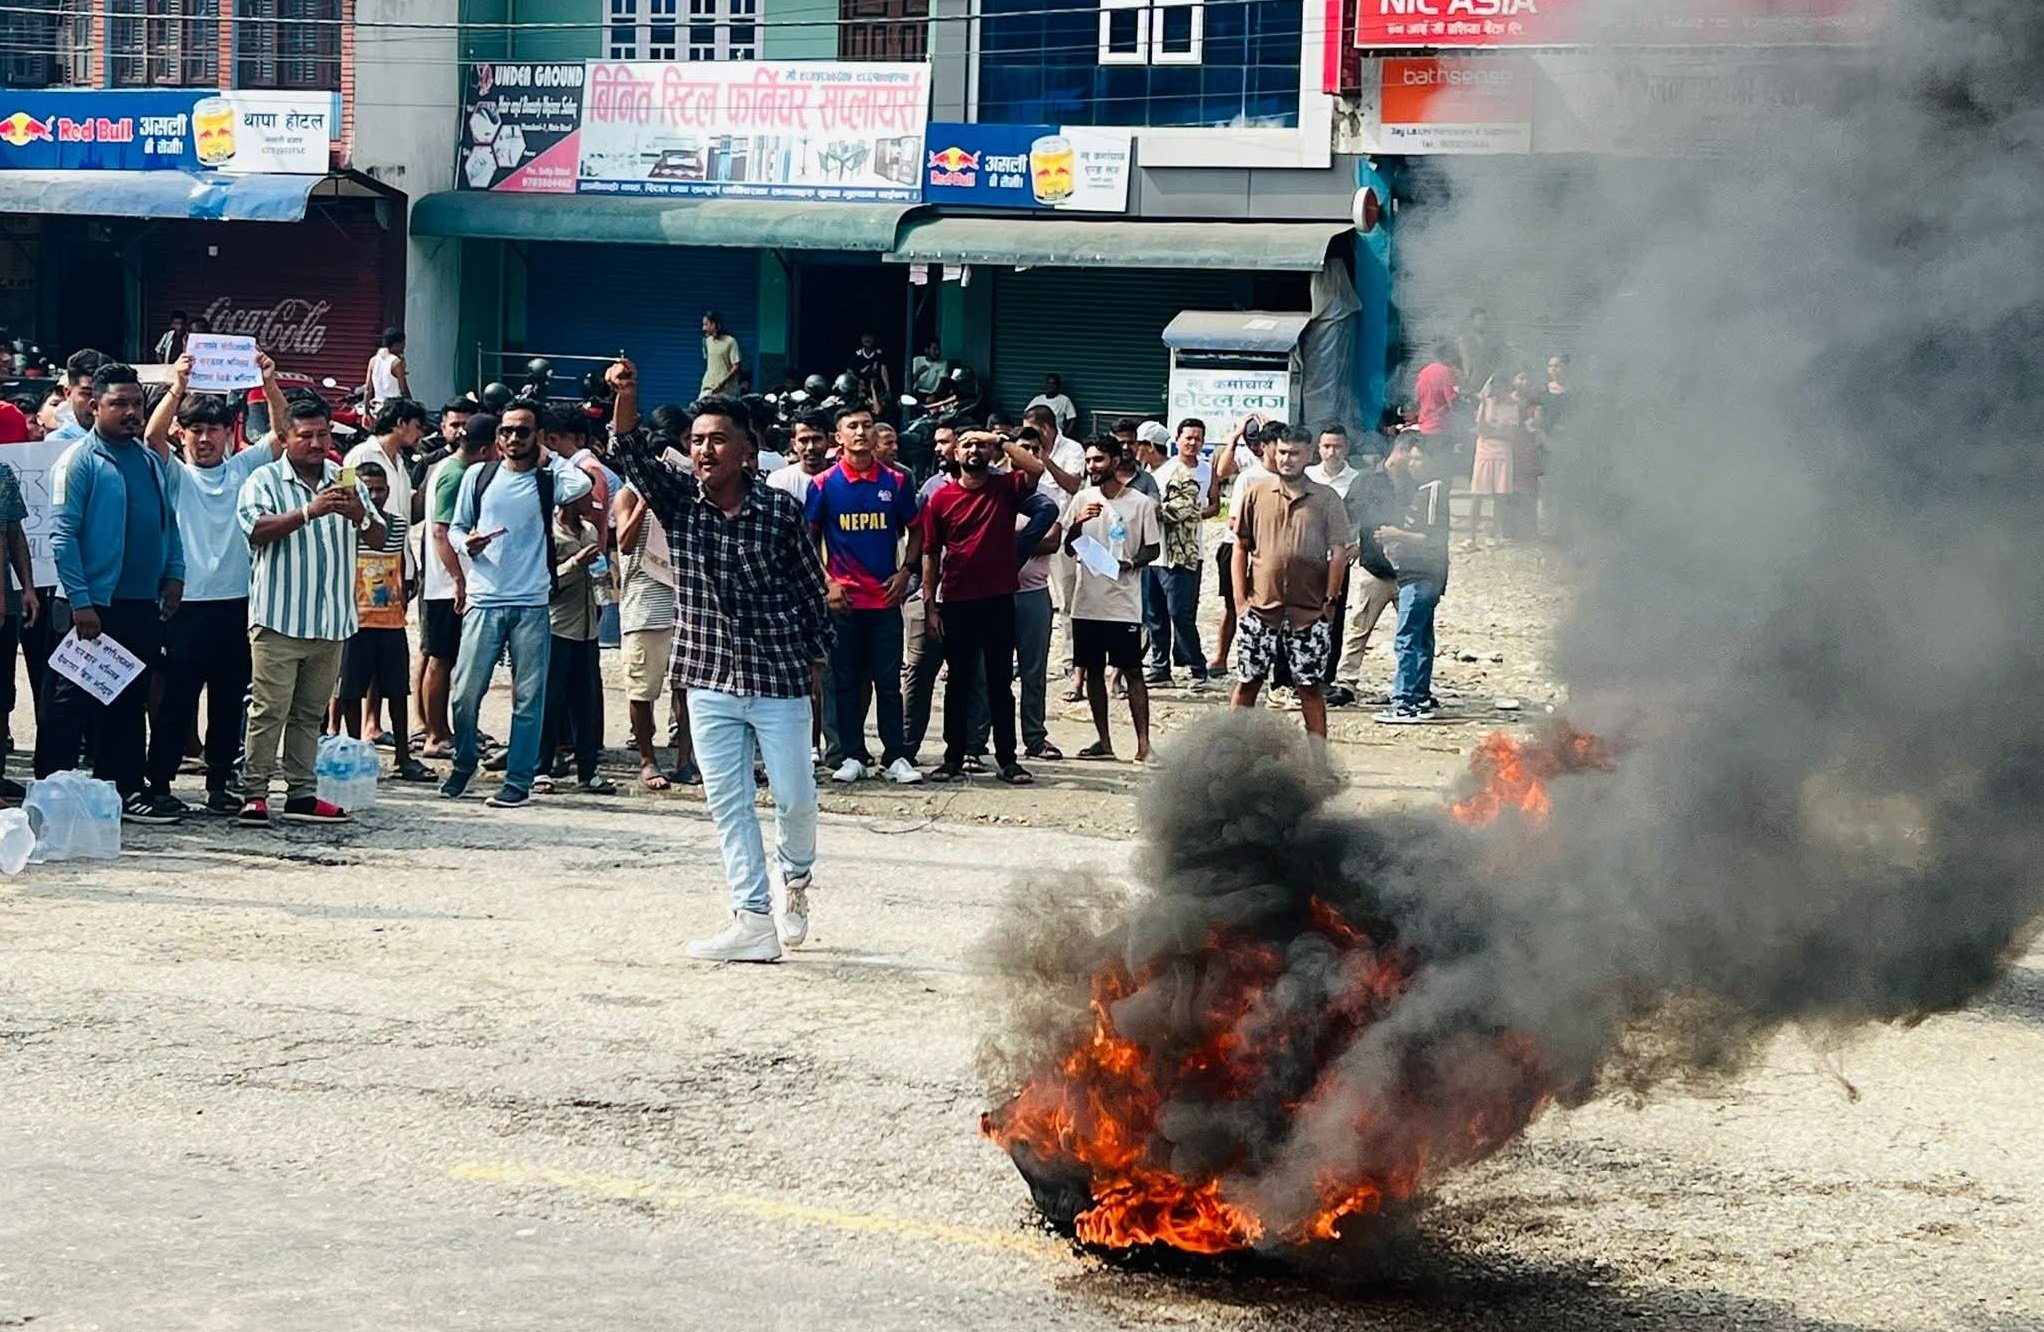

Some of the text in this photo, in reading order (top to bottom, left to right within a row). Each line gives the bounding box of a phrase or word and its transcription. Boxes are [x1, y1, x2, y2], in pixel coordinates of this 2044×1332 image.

[495, 65, 583, 88] UNDER GROUND
[1403, 66, 1514, 86] bathsense
[660, 65, 720, 128] स्टिल
[727, 66, 812, 130] फर्निचर
[58, 117, 134, 142] Red Bull
[139, 113, 188, 137] असली
[244, 109, 325, 131] थापा होटल
[984, 154, 1028, 174] असली
[930, 170, 976, 188] Red Bull
[1175, 387, 1287, 408] होटल लज
[839, 512, 888, 531] NEPAL
